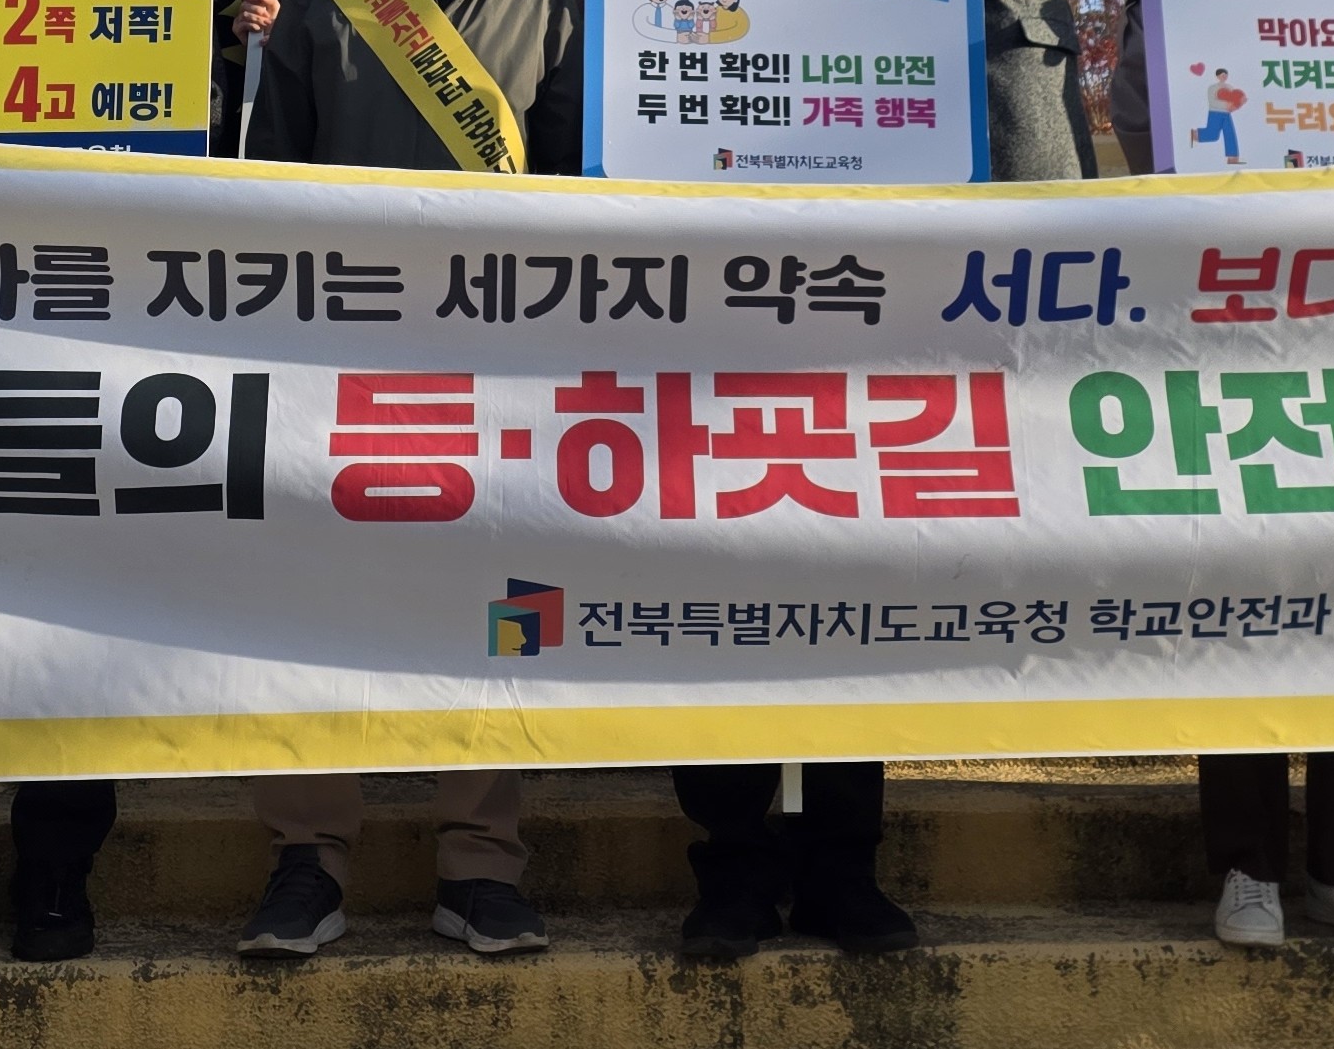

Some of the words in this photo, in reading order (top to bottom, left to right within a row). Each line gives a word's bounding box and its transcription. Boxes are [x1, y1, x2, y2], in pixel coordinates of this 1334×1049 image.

[89, 5, 174, 44] 저쪽!
[638, 50, 669, 81] 한
[680, 52, 708, 82] 번
[719, 53, 791, 84] 확인!
[802, 54, 864, 85] 나의
[874, 55, 937, 86] 안전
[3, 66, 76, 122] 4고
[91, 82, 174, 121] 예방!
[637, 93, 668, 124] 두
[680, 94, 708, 125] 번
[719, 94, 791, 126] 확인!
[803, 96, 864, 127] 가족
[875, 96, 937, 128] 행복
[736, 153, 863, 171] 전북특별자치도교육청
[145, 249, 405, 323] 지키는
[436, 252, 689, 324] 세가지
[723, 254, 887, 325] 약속
[940, 246, 1146, 327] 서다.
[328, 370, 1021, 522] 등·하굣길
[577, 599, 1069, 648] 전북특별자치도교육청
[1089, 594, 1331, 642] 학교안전과
